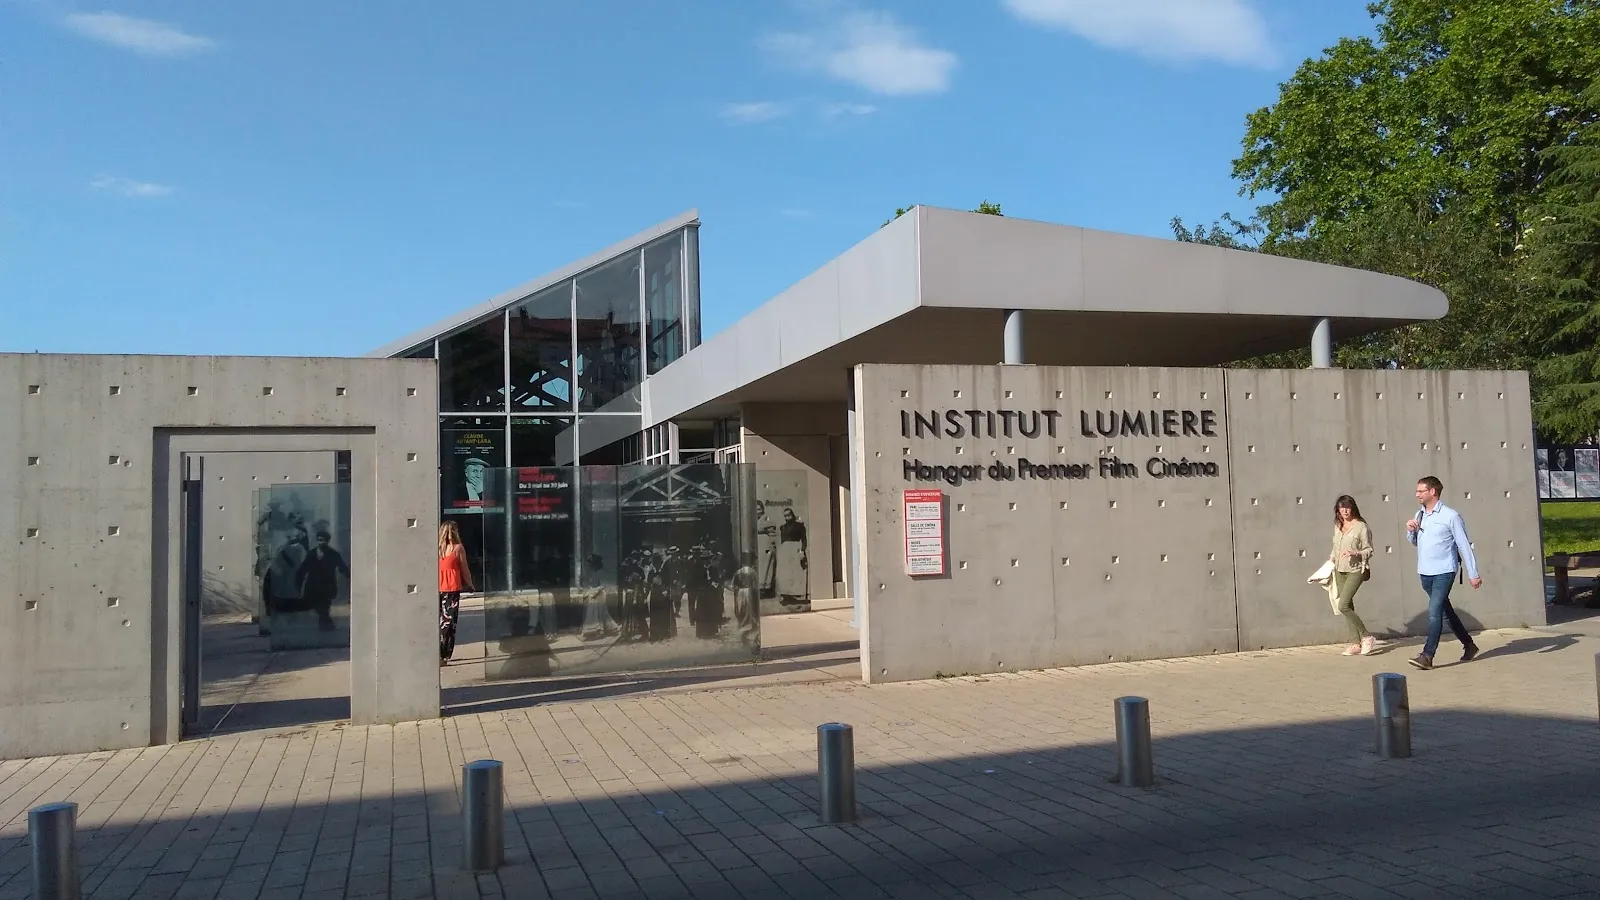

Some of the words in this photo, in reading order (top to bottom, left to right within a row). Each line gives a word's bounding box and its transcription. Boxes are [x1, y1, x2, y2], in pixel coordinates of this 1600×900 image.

[901, 409, 1060, 438] INSTITUT
[1080, 409, 1216, 437] LUMIERE
[903, 458, 984, 486] Hangar
[988, 459, 1014, 481] du
[1018, 457, 1093, 480] Premier
[1098, 456, 1138, 478] Film
